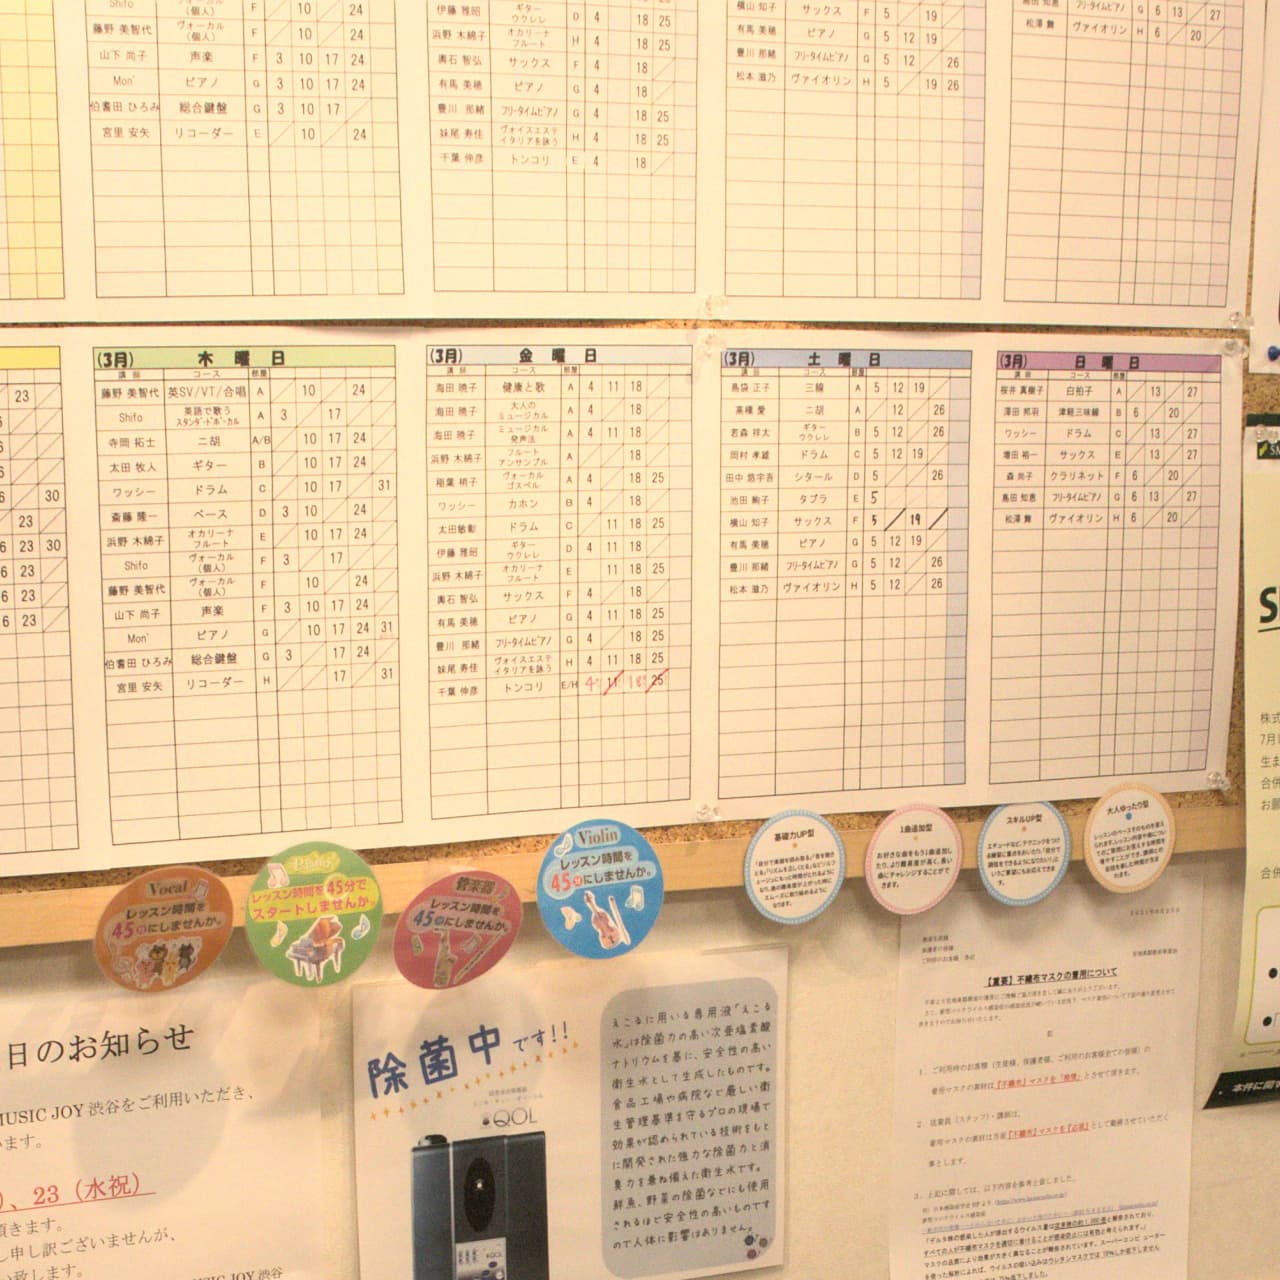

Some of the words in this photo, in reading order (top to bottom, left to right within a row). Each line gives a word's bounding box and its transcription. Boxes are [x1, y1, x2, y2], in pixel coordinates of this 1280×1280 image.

[502, 381, 546, 393] 健康と歌
[794, 471, 833, 482] シタール
[932, 469, 944, 481] 26
[1049, 470, 1104, 482] クラリネット
[1168, 469, 1179, 481] 20
[505, 681, 544, 693] トンコリ
[578, 828, 618, 846] Violin
[560, 851, 632, 870] レッスン時間を
[148, 880, 188, 896] Vocal
[456, 877, 495, 894] 管楽器
[254, 896, 375, 919] スタートしませんか。
[51, 1103, 84, 1122] JOY
[257, 1267, 283, 1280] 渋谷
